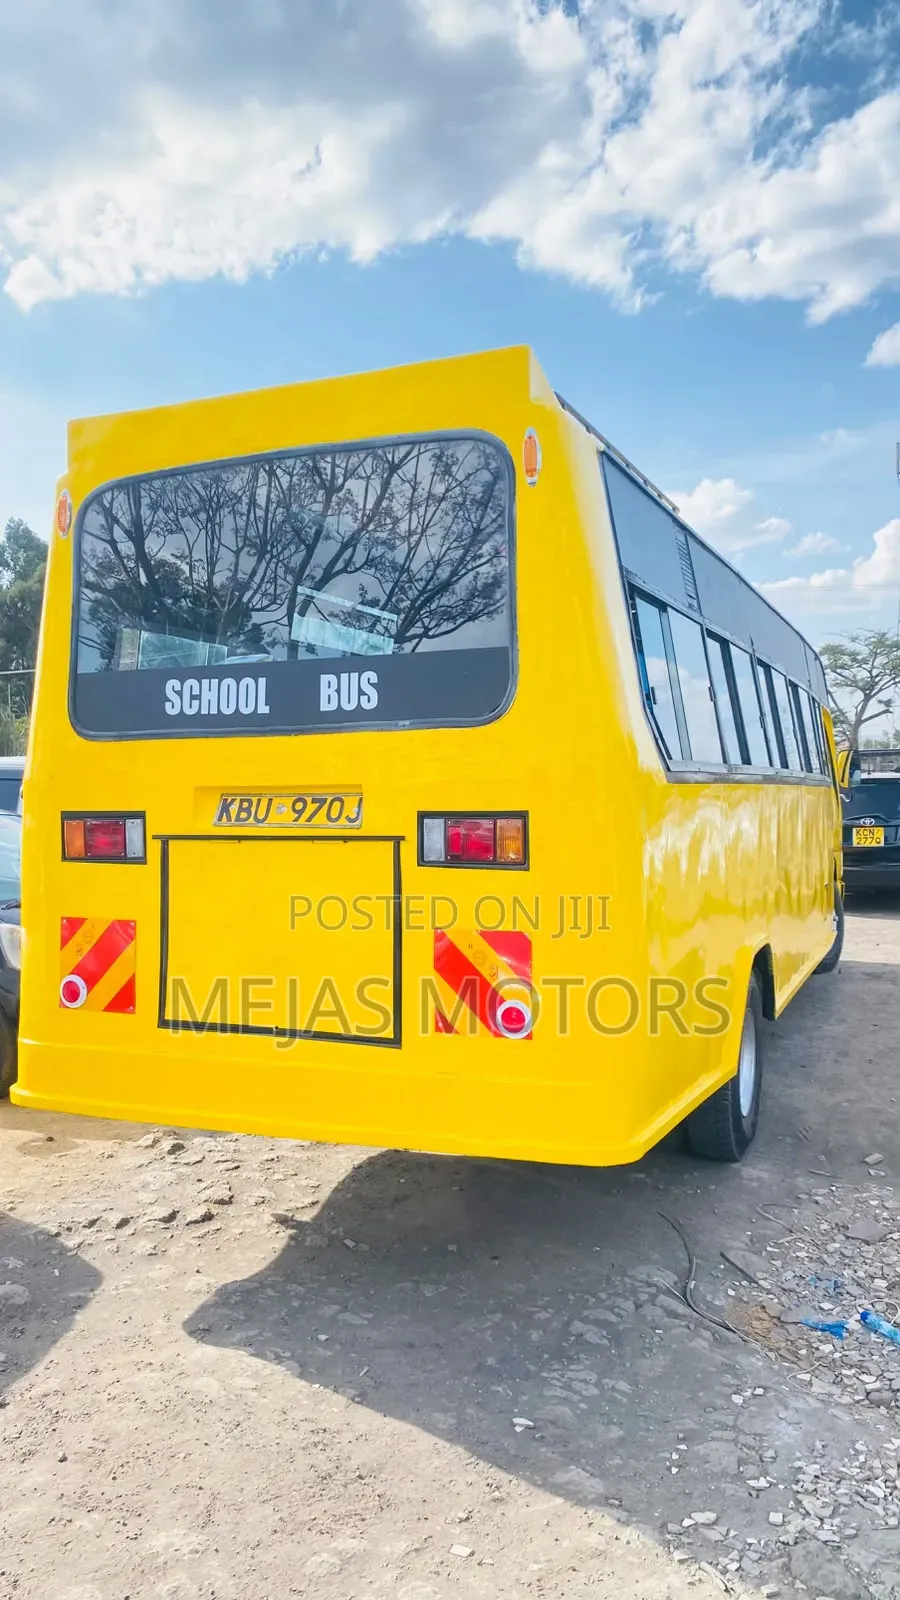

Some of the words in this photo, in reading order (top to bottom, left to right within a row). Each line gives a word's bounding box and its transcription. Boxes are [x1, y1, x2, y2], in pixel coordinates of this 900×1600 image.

[164, 677, 270, 716] SCHOOL
[319, 671, 379, 712] BUS
[217, 797, 273, 824] KBU
[291, 796, 363, 824] 970J
[855, 828, 875, 837] KCN
